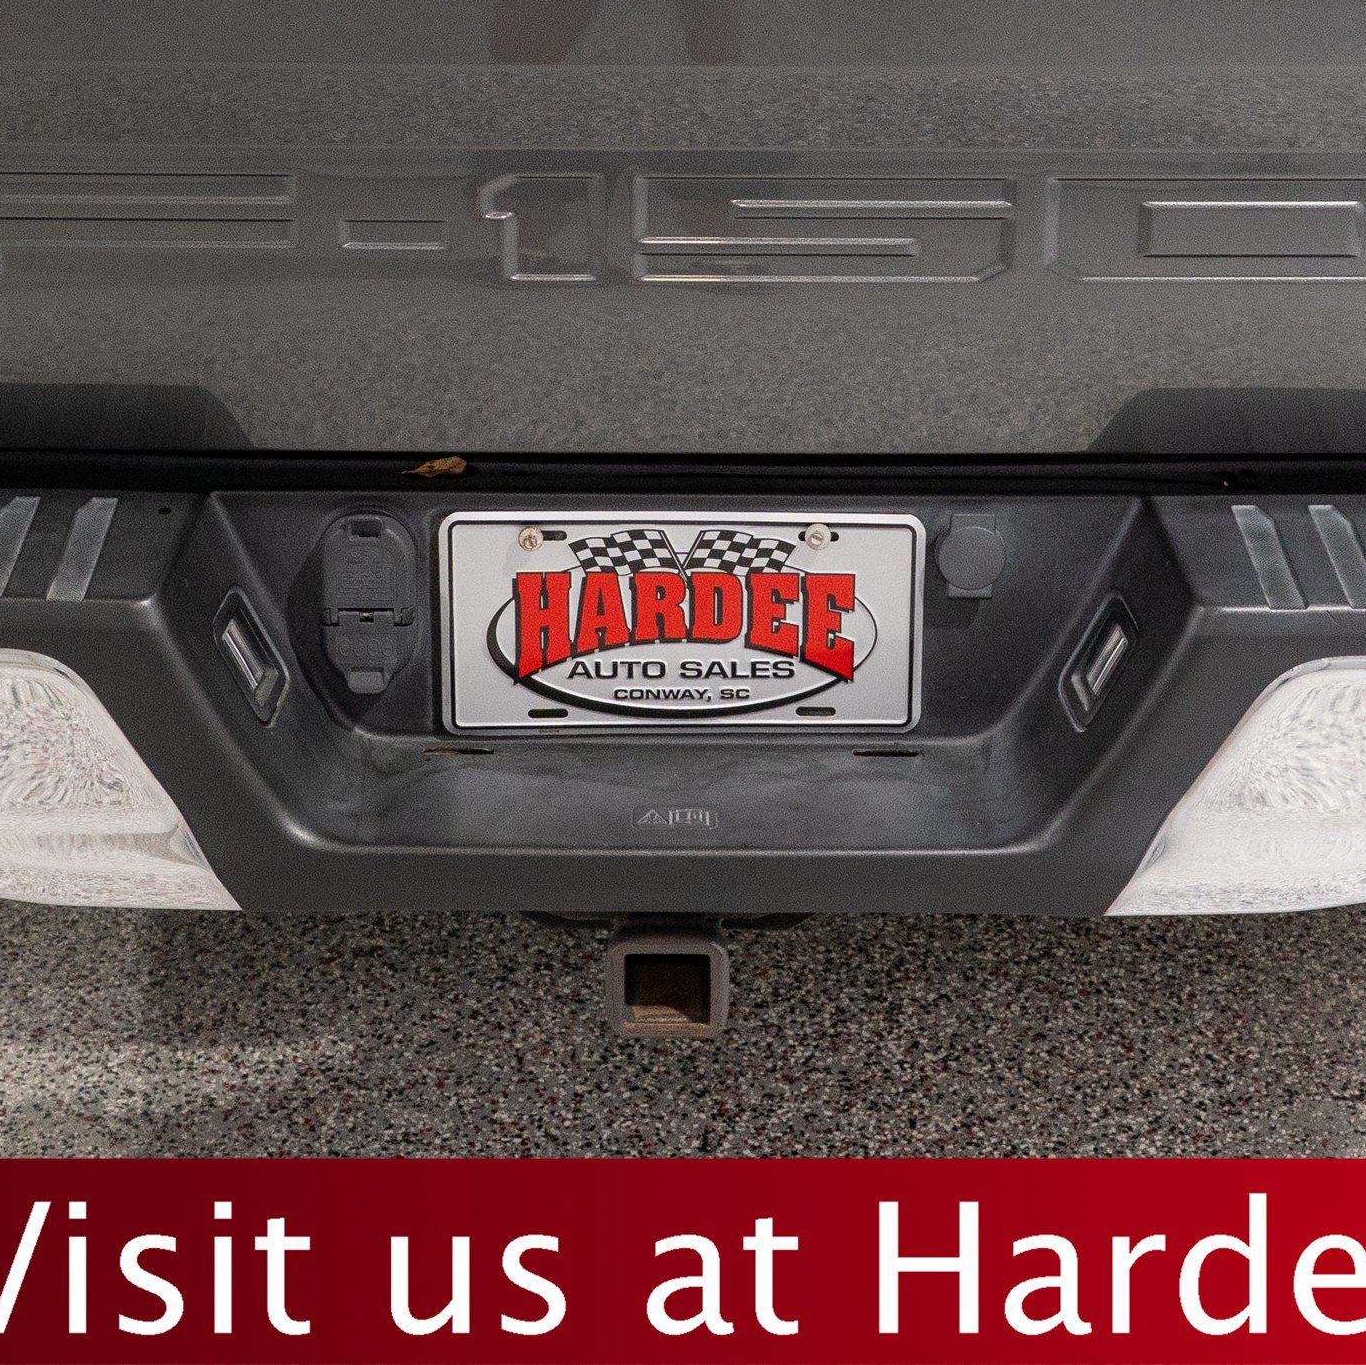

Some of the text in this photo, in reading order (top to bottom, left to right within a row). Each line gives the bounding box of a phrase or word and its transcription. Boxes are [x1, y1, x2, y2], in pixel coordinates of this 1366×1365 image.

[512, 571, 855, 682] HARDEE
[567, 660, 796, 679] AUTO SALES
[613, 688, 751, 702] CONWAY, SC
